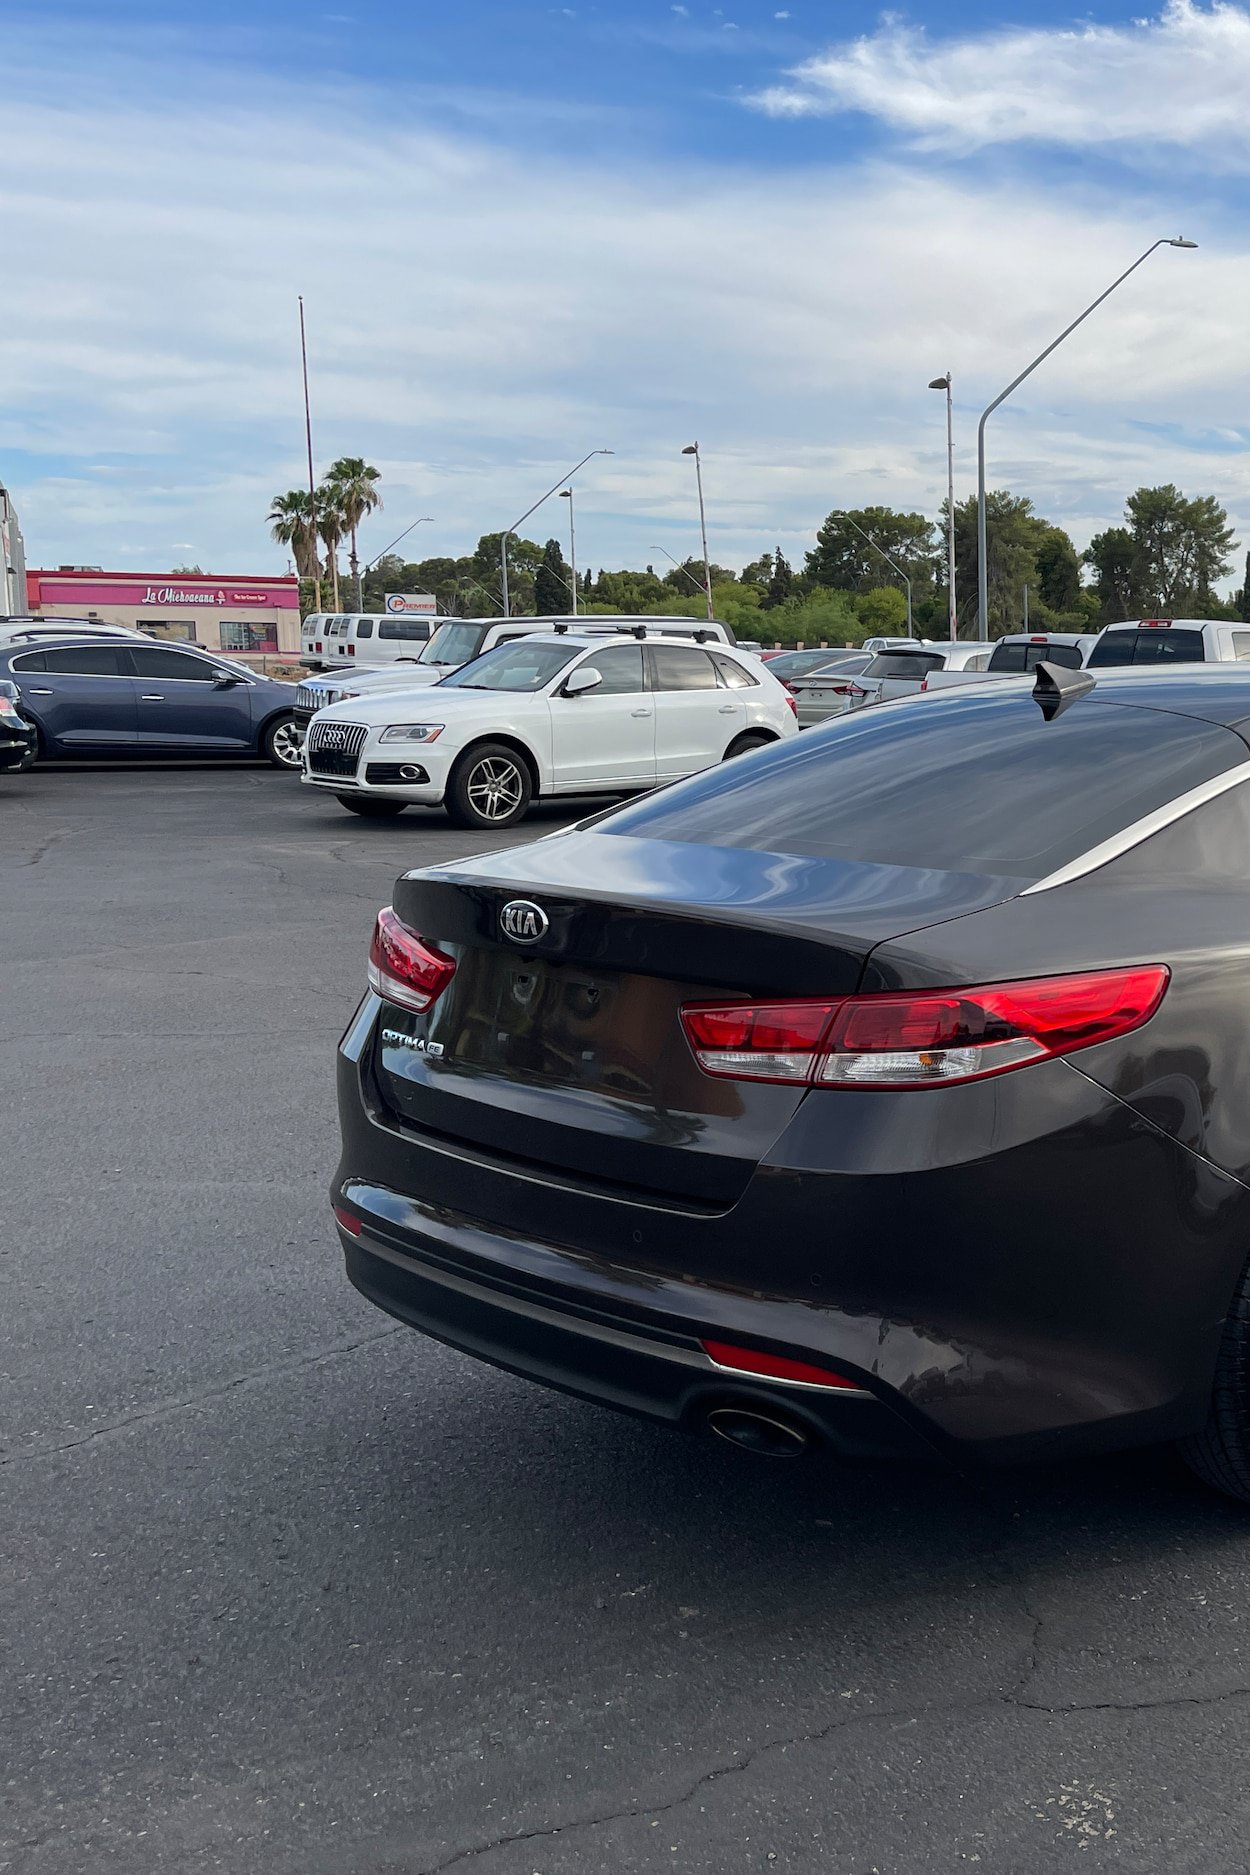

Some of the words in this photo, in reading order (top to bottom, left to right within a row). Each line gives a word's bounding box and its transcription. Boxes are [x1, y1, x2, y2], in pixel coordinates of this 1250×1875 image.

[142, 587, 156, 603] La
[158, 588, 214, 603] Michoacana
[506, 909, 537, 935] KIA
[382, 1029, 426, 1052] OPTIMA
